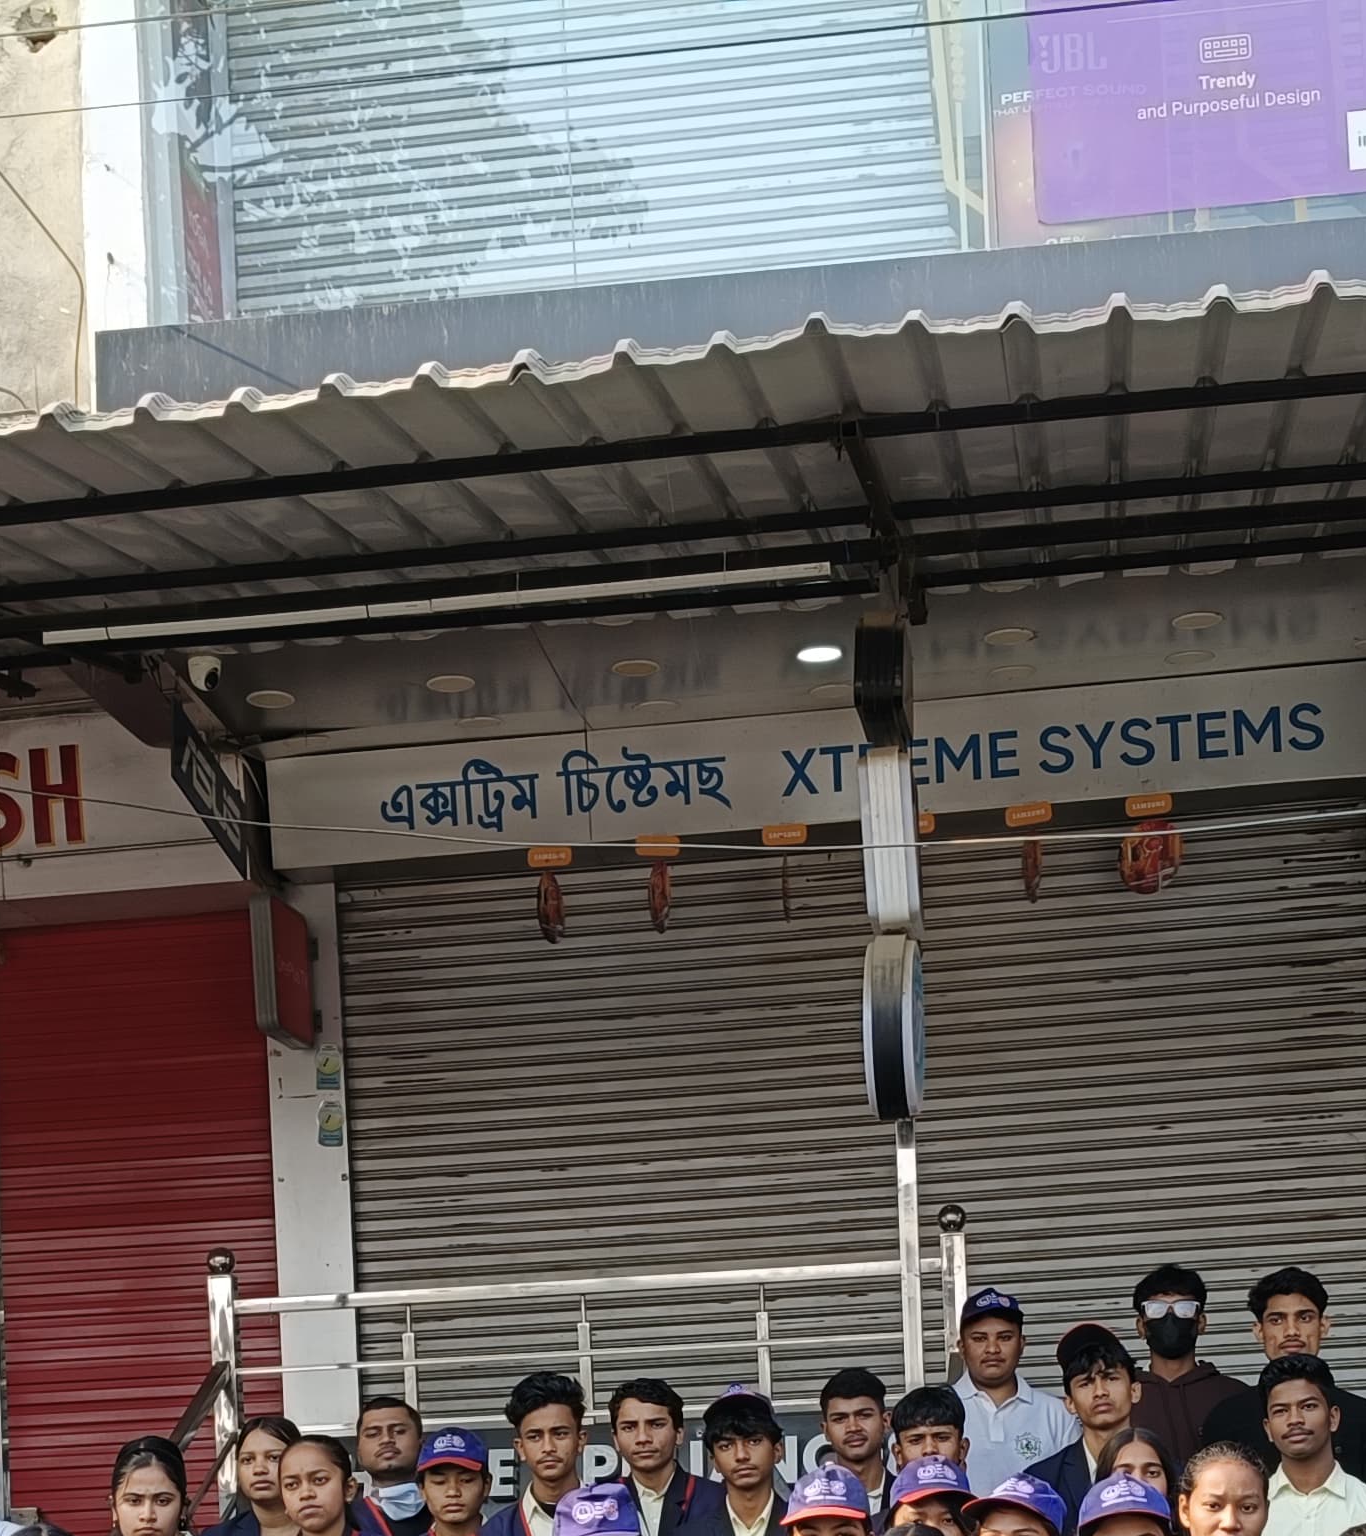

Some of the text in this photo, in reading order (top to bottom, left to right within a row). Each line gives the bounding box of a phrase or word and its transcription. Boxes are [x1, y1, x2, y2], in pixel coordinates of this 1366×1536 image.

[1198, 71, 1257, 91] Trendy
[1137, 87, 1322, 120] and Purposeful Design
[782, 702, 1325, 799] XTEME SYSTEMS
